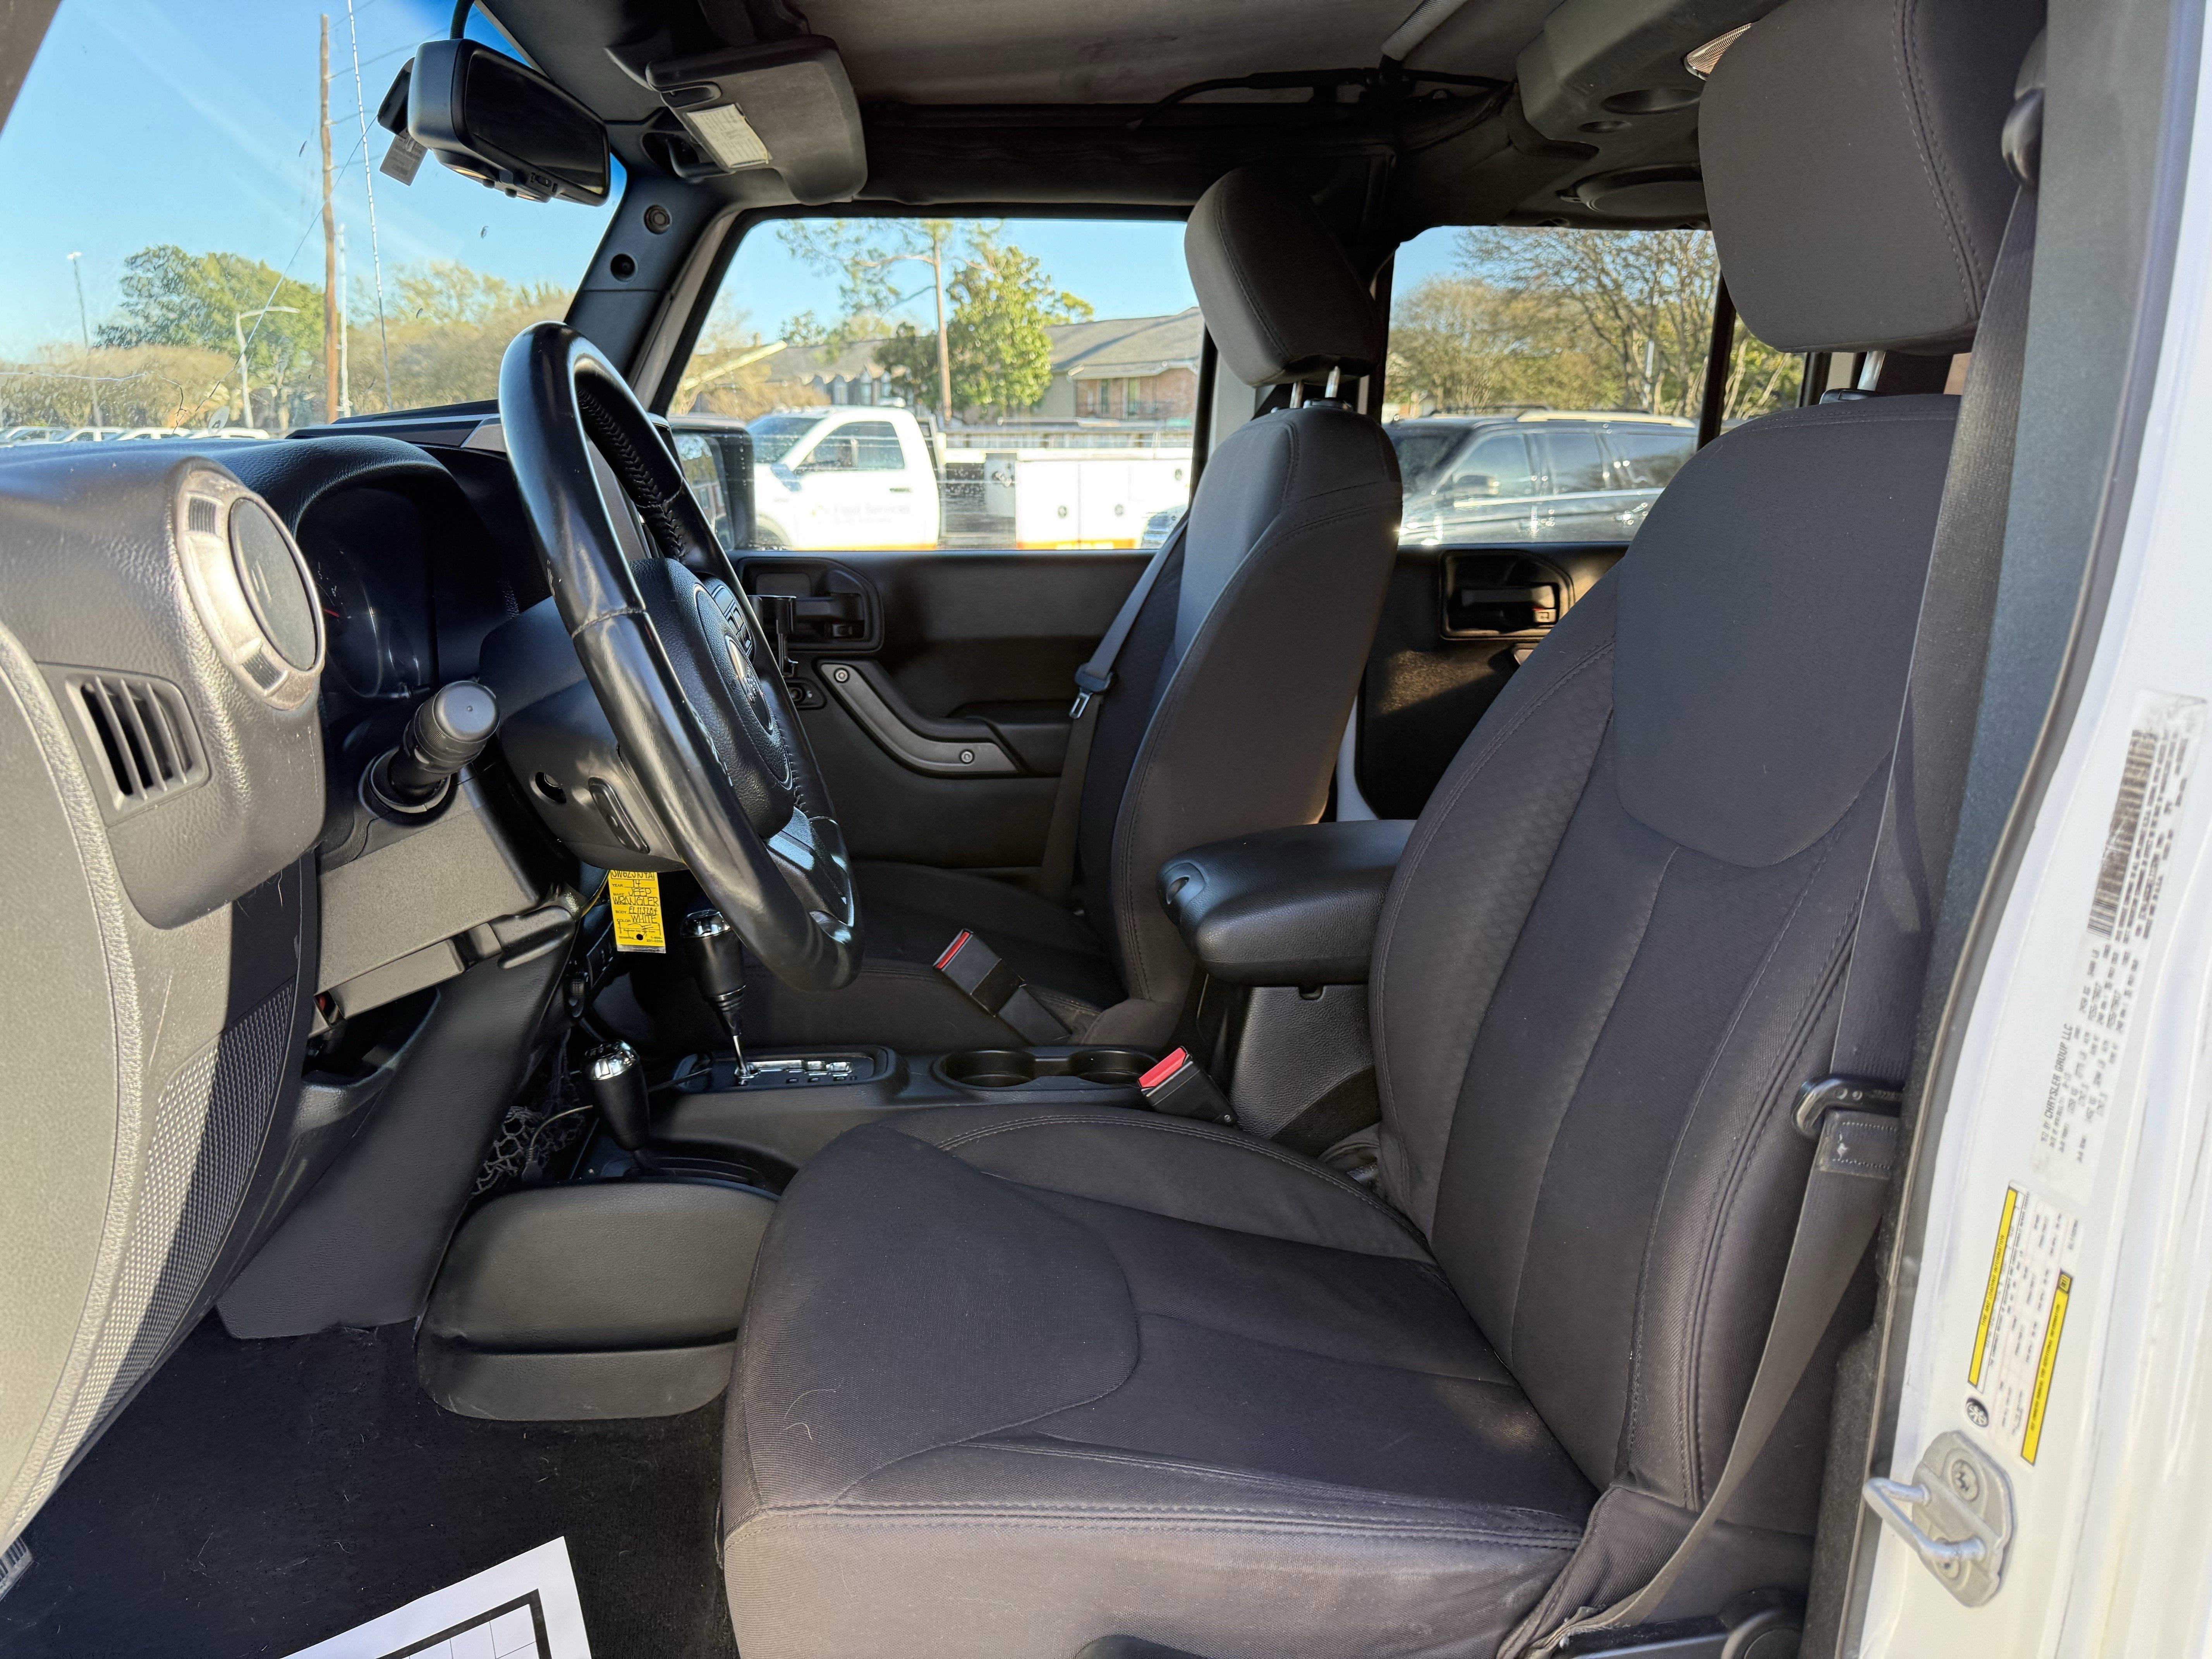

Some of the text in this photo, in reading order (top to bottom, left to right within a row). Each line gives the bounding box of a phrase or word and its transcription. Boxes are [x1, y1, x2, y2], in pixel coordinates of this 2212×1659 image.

[629, 888, 651, 896] JEEP
[613, 896, 659, 906] WRANGLER
[631, 915, 658, 923] WHITE
[2044, 1073, 2061, 1119] CHRYSLER
[2054, 1042, 2068, 1072] GROUP
[2061, 1023, 2073, 1041] LLC
